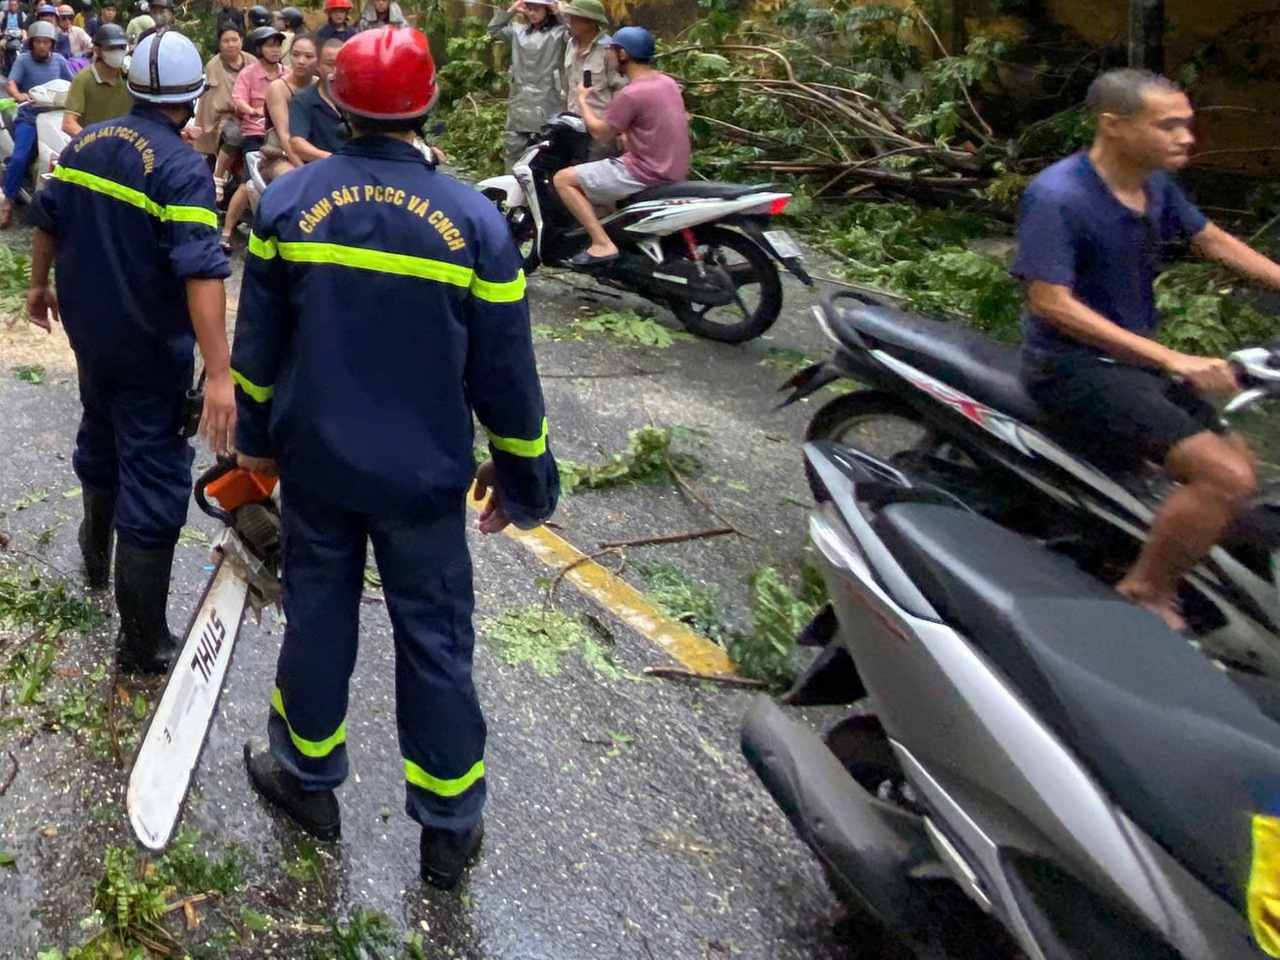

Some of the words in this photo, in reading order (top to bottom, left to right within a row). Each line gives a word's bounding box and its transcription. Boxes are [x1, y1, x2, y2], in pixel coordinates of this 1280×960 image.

[298, 197, 333, 234] CẢNH
[331, 185, 361, 207] SÁT
[364, 184, 406, 206] PCCC
[406, 195, 431, 218] VÀ
[427, 210, 467, 251] CNCH
[191, 606, 227, 683] STIHL
